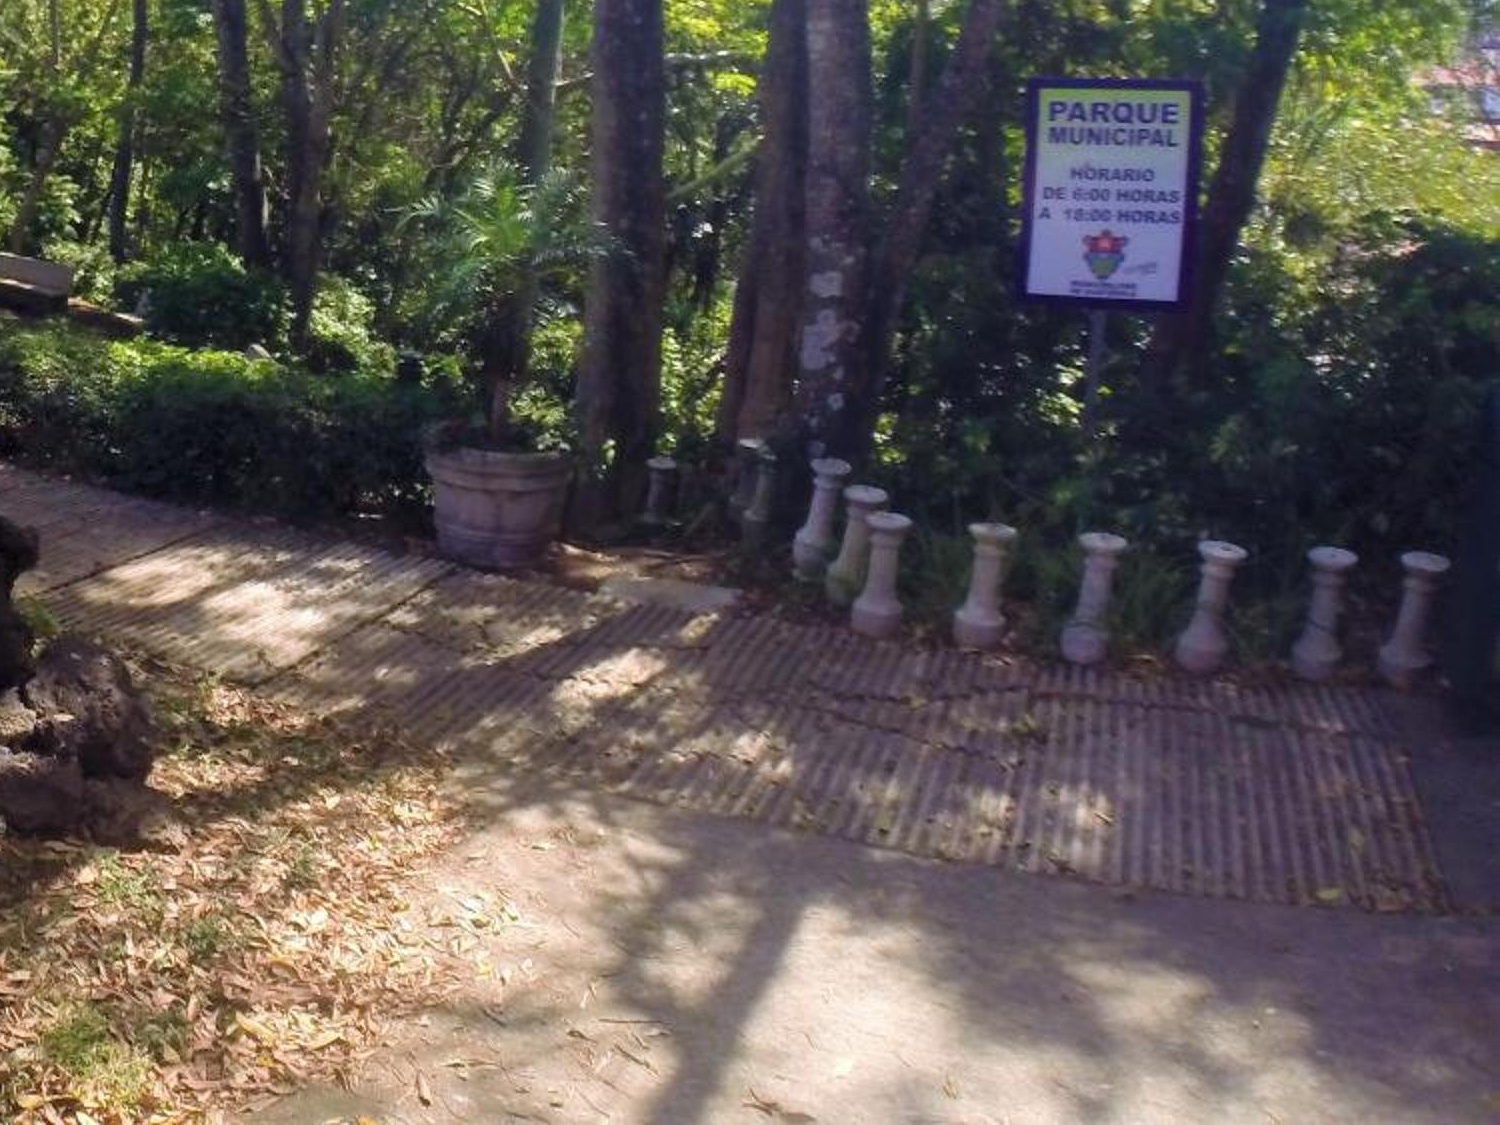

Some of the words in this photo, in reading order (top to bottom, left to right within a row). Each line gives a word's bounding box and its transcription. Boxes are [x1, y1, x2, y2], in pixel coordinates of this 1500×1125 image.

[1048, 101, 1179, 124] PARQUE
[1048, 127, 1178, 147] MUNICIPAL
[1070, 168, 1155, 182] HORARIO
[1043, 187, 1065, 200] DE
[1072, 188, 1110, 202] 6:00
[1116, 189, 1180, 203] HORAS
[1038, 207, 1051, 219] A
[1117, 210, 1180, 224] HORAS
